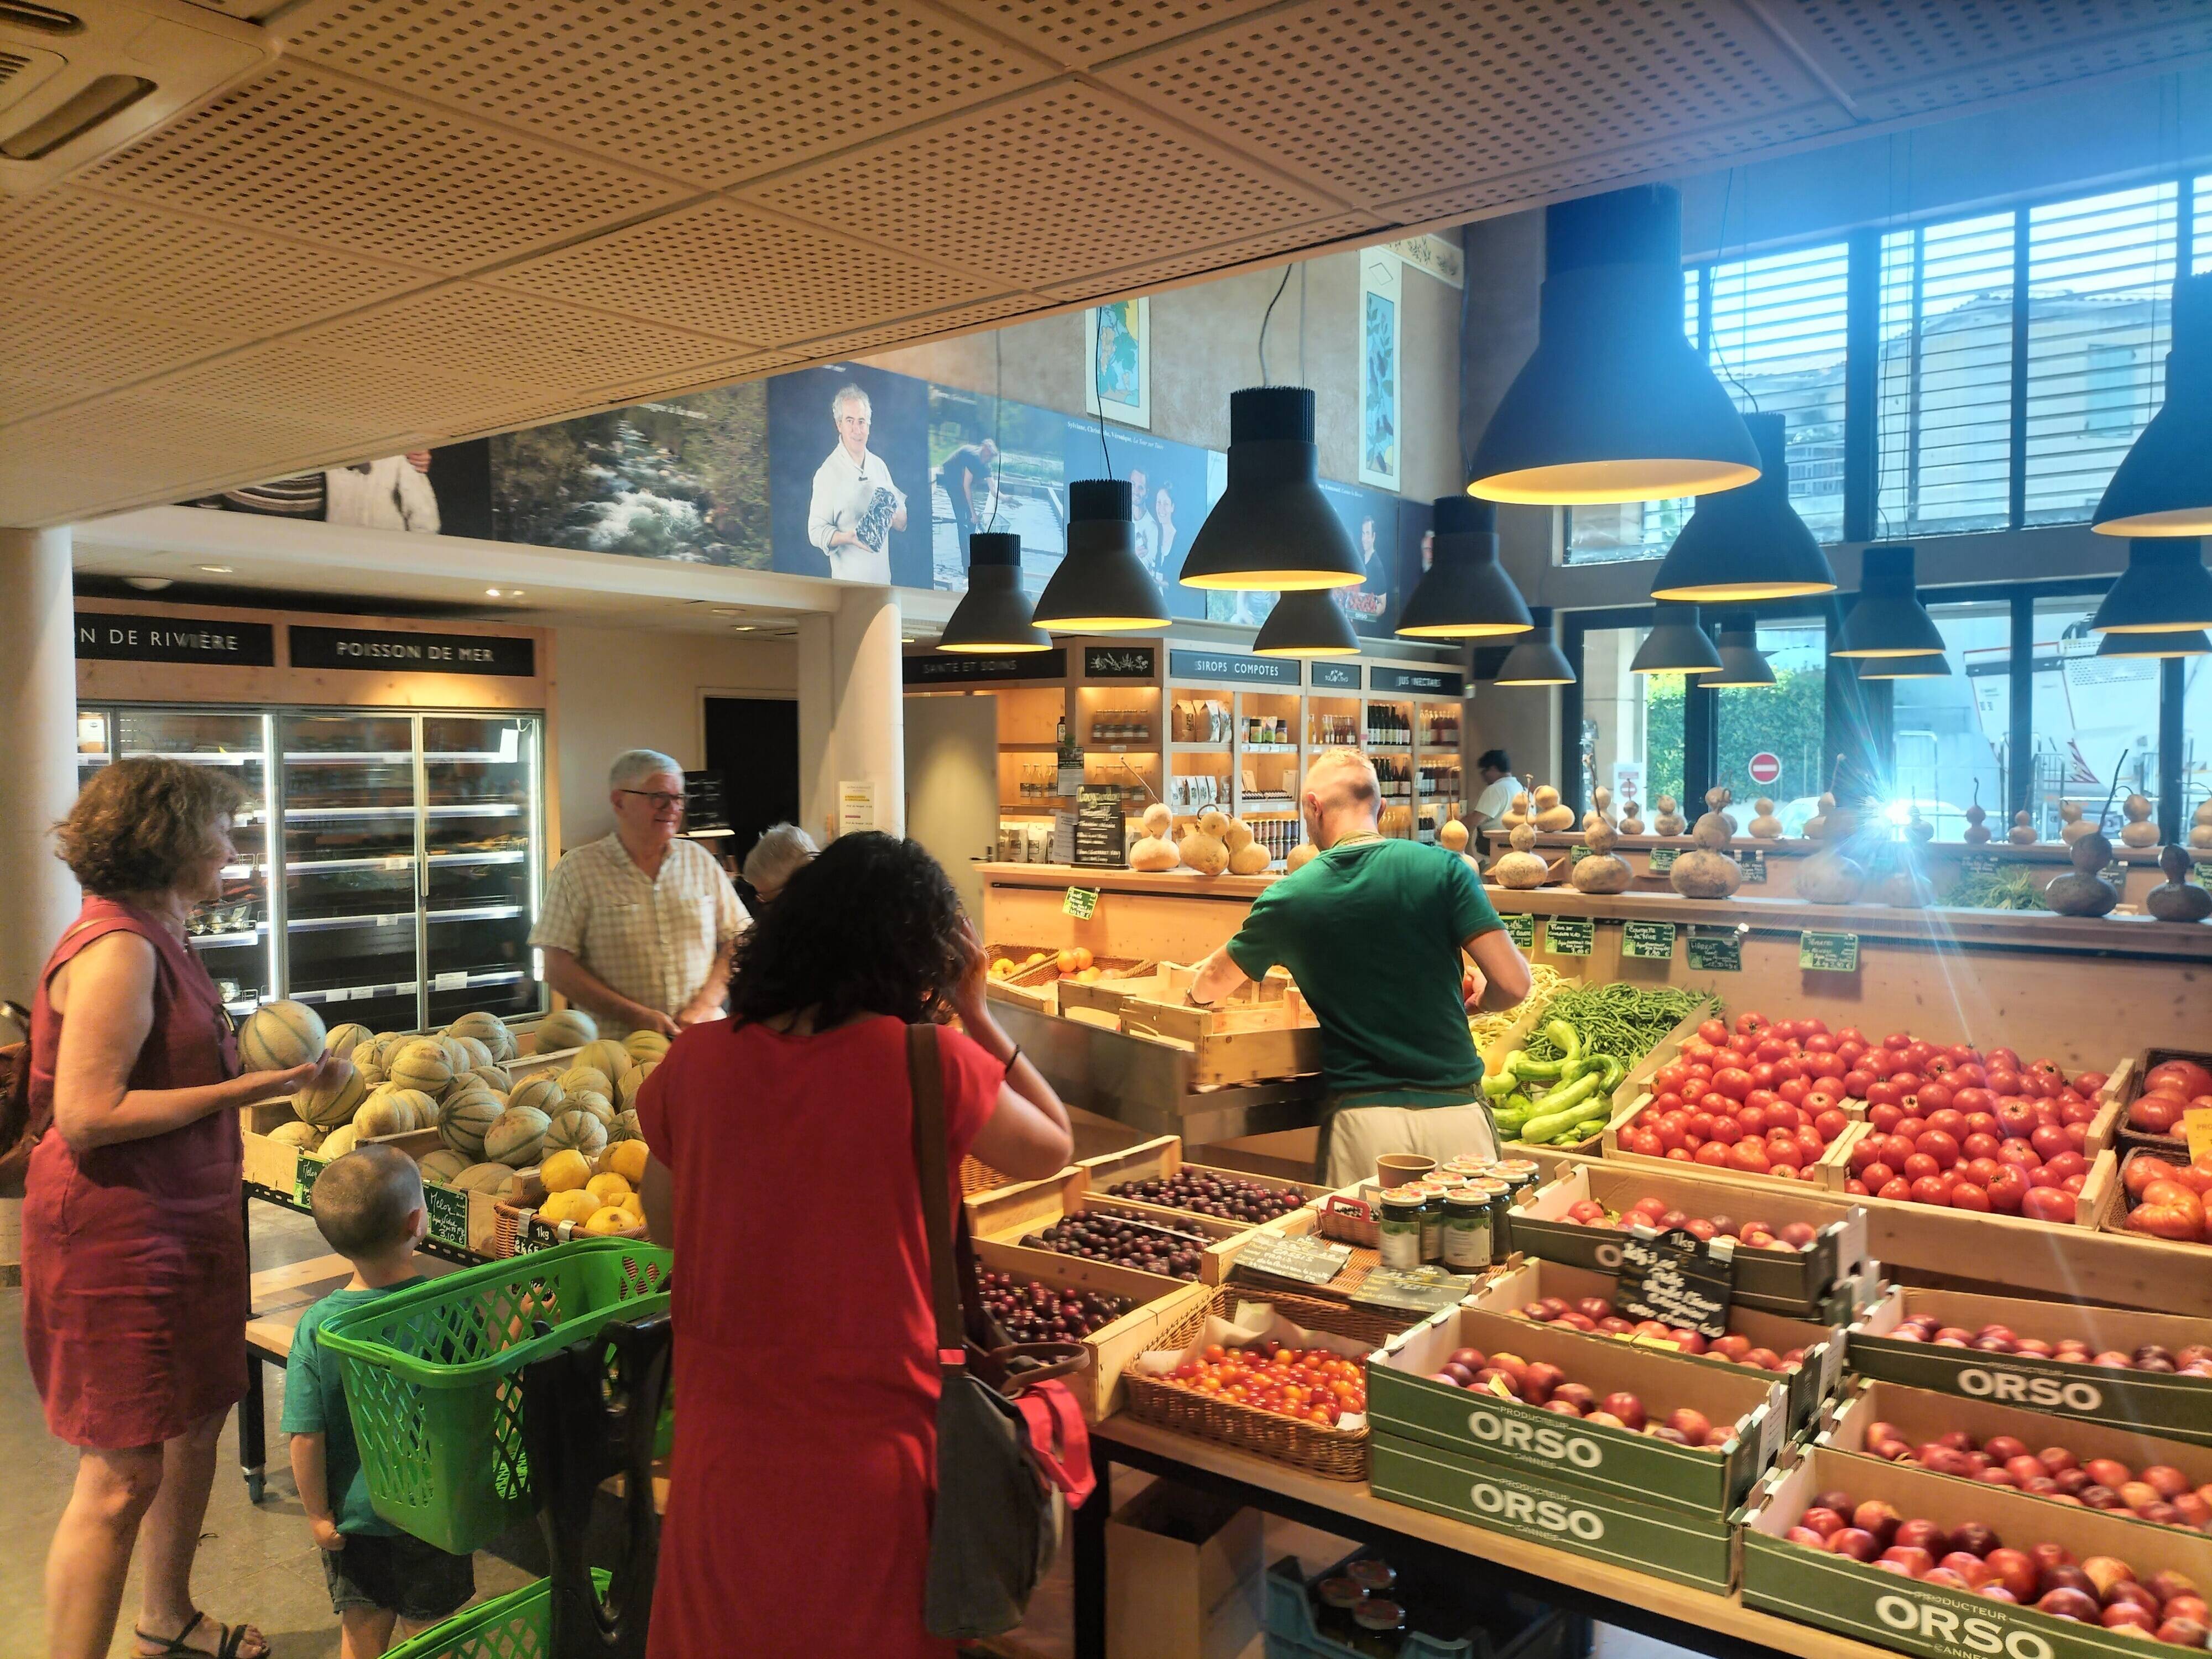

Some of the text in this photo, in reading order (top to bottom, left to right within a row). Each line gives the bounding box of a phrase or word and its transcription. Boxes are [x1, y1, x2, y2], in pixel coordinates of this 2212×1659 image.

[109, 629, 138, 645] DE
[150, 631, 238, 650] RIVIÈRE
[336, 641, 494, 662] POISSON DE MER
[1196, 660, 1279, 676] SIROPS COMPOTES
[1397, 676, 1410, 687] JUS
[430, 1191, 456, 1215] Melon
[536, 1225, 550, 1240] 1kg
[1670, 1232, 1696, 1252] 1kg
[1958, 1369, 2102, 1410] ORSO
[1500, 1406, 1569, 1428] PRODUCTEUR
[1468, 1411, 1603, 1468] ORSO
[1512, 1453, 1557, 1469] CANNES
[1500, 1478, 1571, 1501] PRODUCTEUR
[1470, 1483, 1604, 1540] ORSO
[1514, 1525, 1559, 1541] CANNES
[1914, 1591, 2007, 1621] PRODUCTEUR
[1875, 1595, 2055, 1659] ORSO
